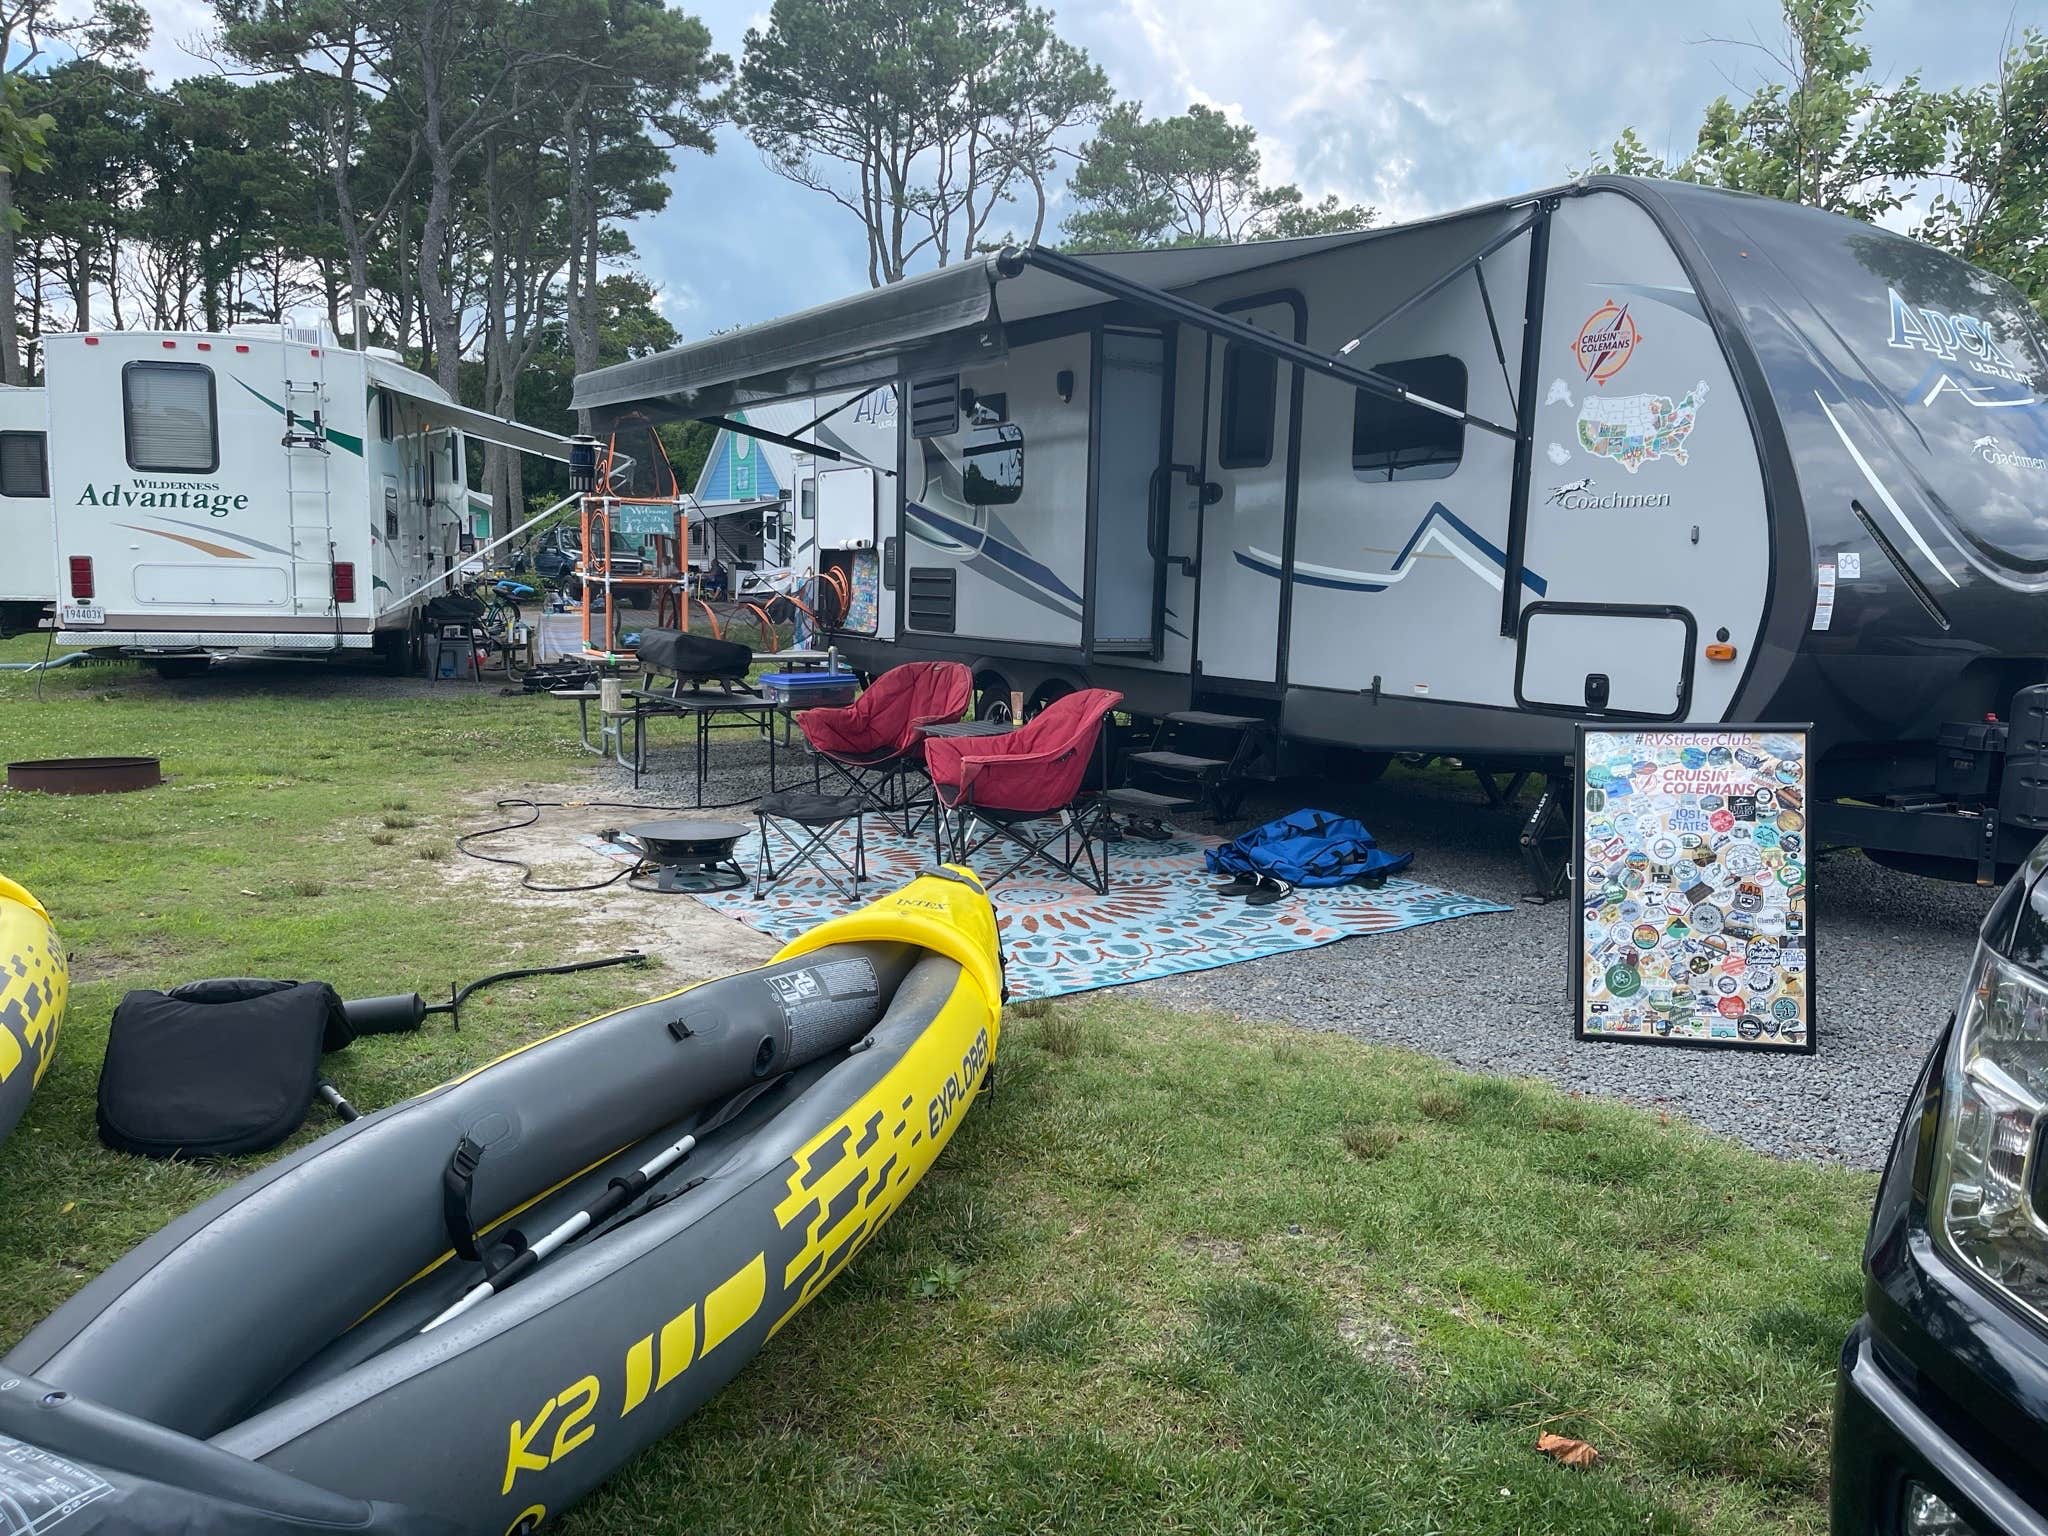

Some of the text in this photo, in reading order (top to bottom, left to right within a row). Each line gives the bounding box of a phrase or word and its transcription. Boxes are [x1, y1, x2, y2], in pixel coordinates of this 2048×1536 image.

[1888, 287, 2015, 368] Apex
[1581, 340, 1630, 353] COLEMANS
[1969, 359, 2035, 386] ULTRA LITE
[853, 388, 899, 424] Ape
[1982, 449, 2046, 469] Coachmen
[76, 483, 249, 517] Advantage
[1563, 491, 1671, 510] Coachmen
[1663, 782, 1756, 796] COLEMANS
[1669, 819, 1708, 831] STATES
[1739, 883, 1760, 895] RAD
[929, 1027, 989, 1140] EXPLORER
[501, 1374, 600, 1496] K2
